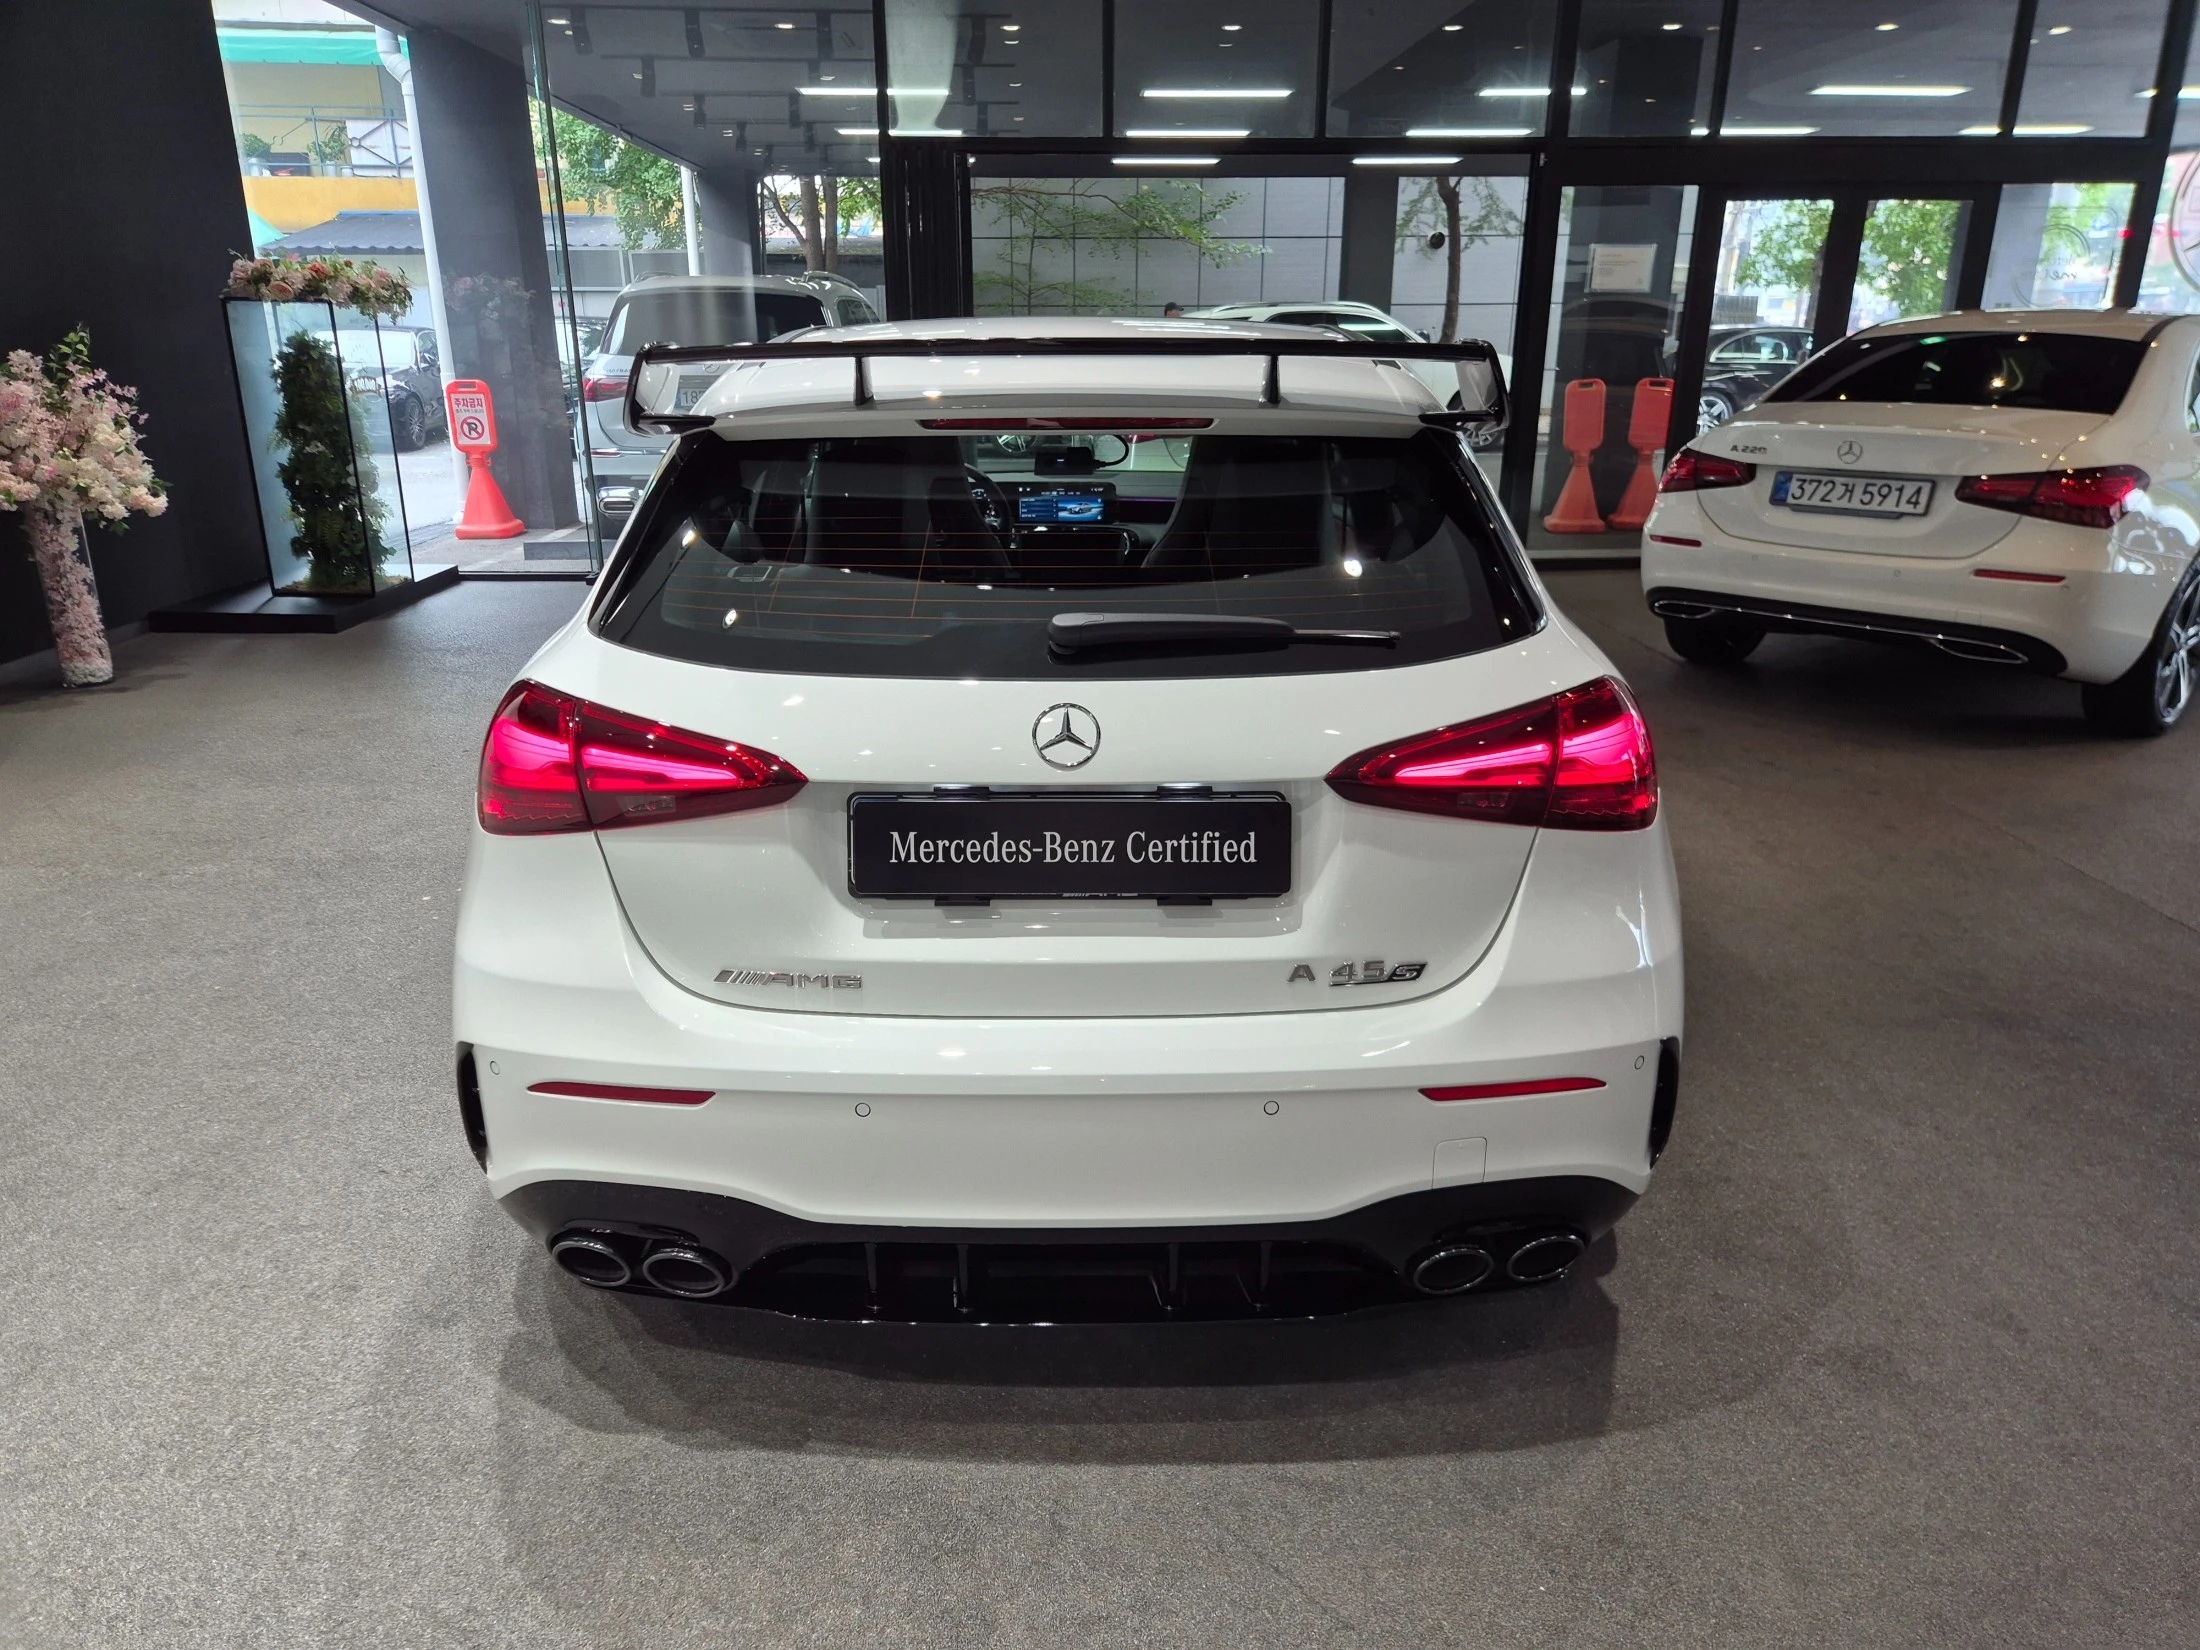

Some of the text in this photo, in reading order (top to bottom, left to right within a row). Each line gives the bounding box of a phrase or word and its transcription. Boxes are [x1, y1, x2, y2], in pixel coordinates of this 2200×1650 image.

[454, 397, 483, 408] 주차금지
[889, 831, 1258, 863] Mercedes-Benz Certified
[1288, 964, 1316, 982] A
